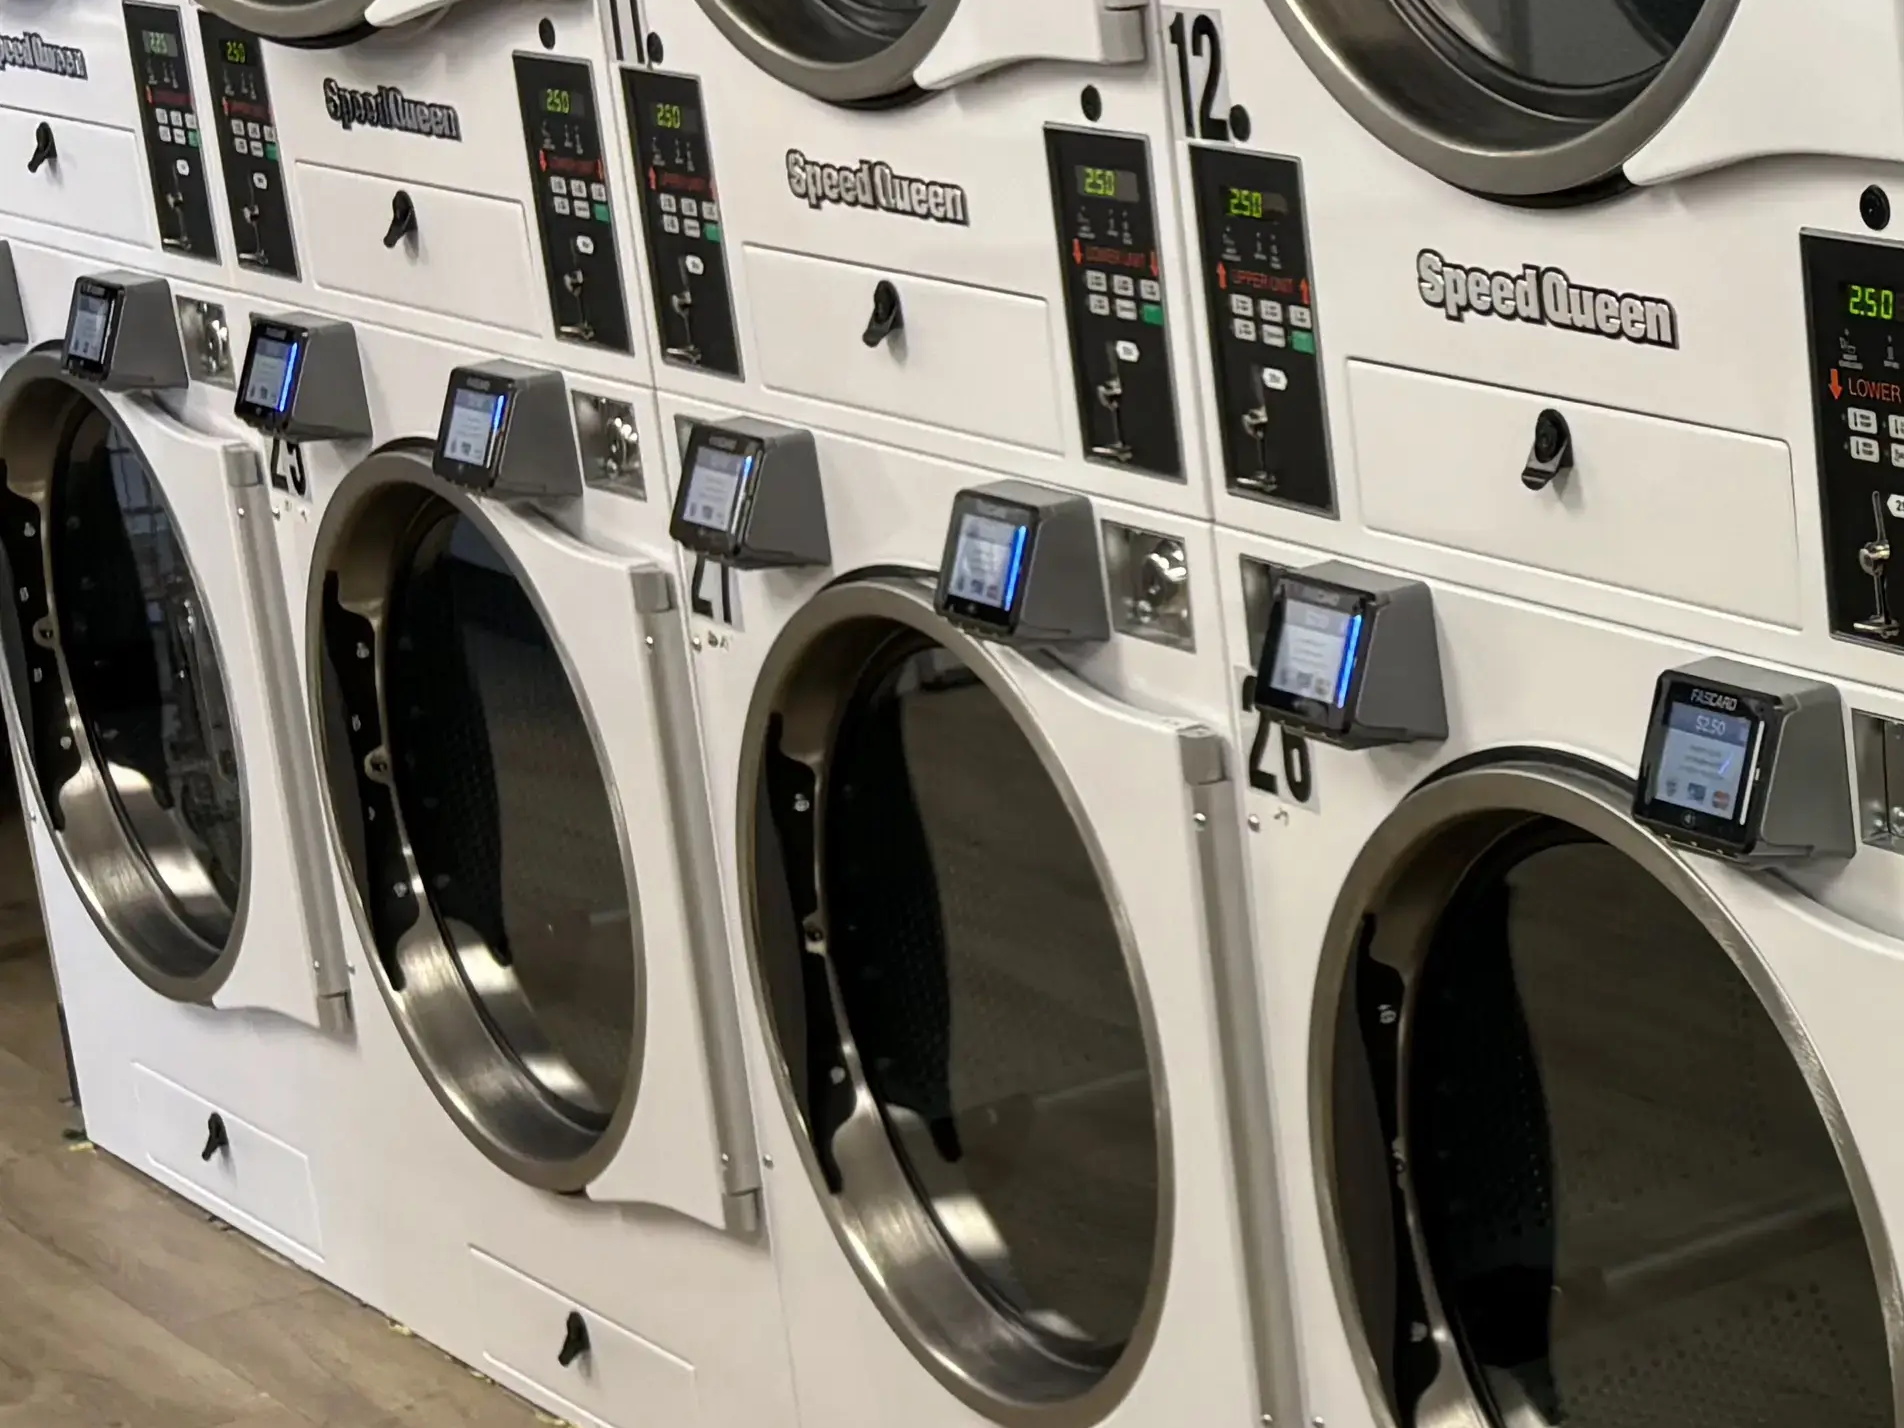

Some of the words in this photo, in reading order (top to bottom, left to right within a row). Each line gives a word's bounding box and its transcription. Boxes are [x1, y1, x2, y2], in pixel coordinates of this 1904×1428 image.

[323, 76, 390, 131] Speed
[386, 86, 463, 143] Queen
[1168, 11, 1230, 142] 12
[786, 147, 879, 211] Speed
[872, 160, 971, 228] Queen
[1416, 247, 1547, 327] Speed
[1540, 266, 1680, 350] Queen
[1849, 284, 1894, 320] 2.50
[1847, 376, 1902, 404] LOWER
[1690, 687, 1738, 712] FASCARD
